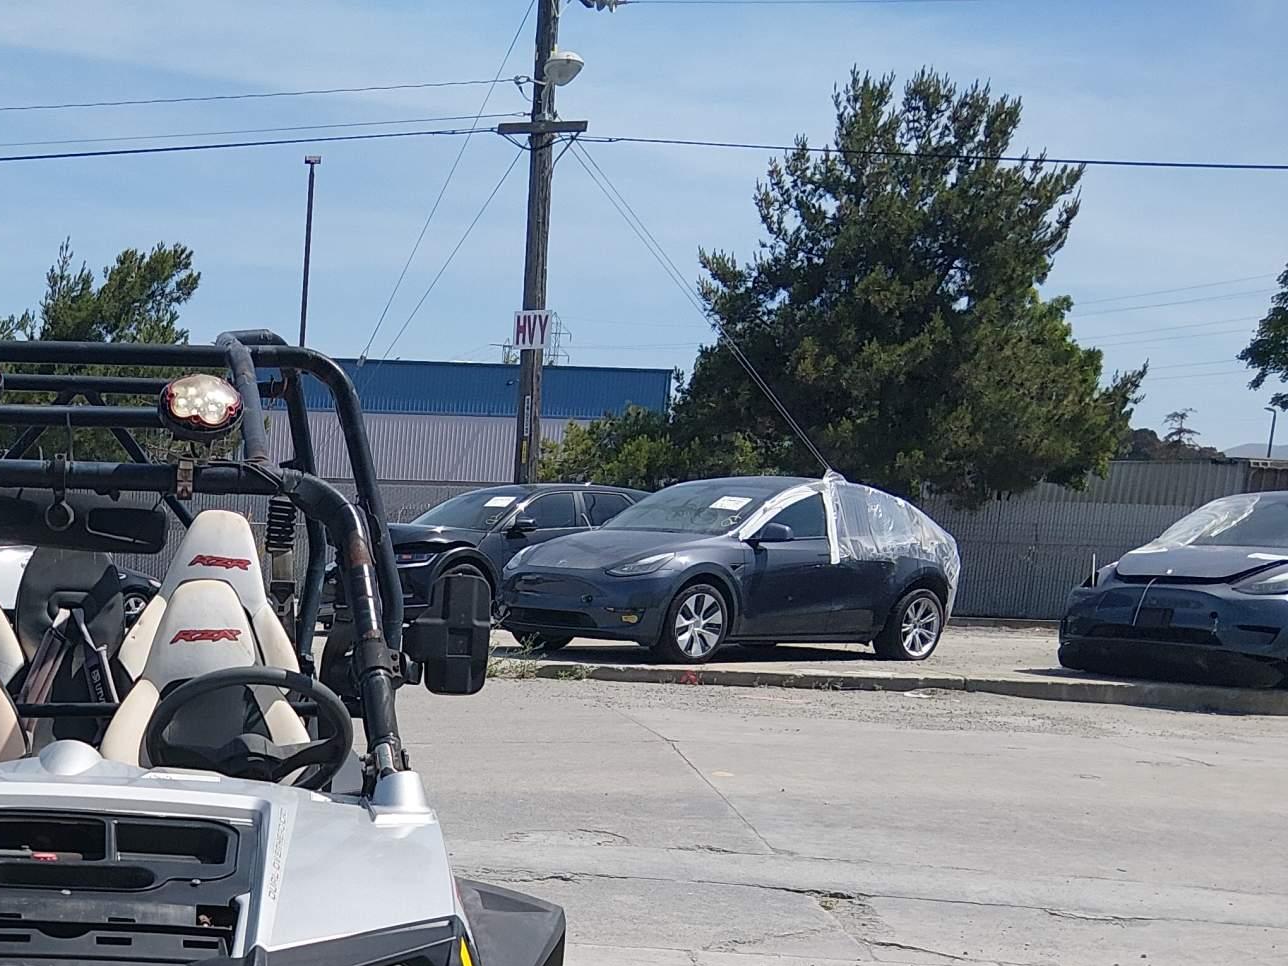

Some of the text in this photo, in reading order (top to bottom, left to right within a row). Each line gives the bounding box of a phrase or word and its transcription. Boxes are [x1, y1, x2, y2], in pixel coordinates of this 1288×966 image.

[515, 314, 549, 346] HVY
[188, 554, 252, 571] RZR
[169, 629, 242, 645] RZR
